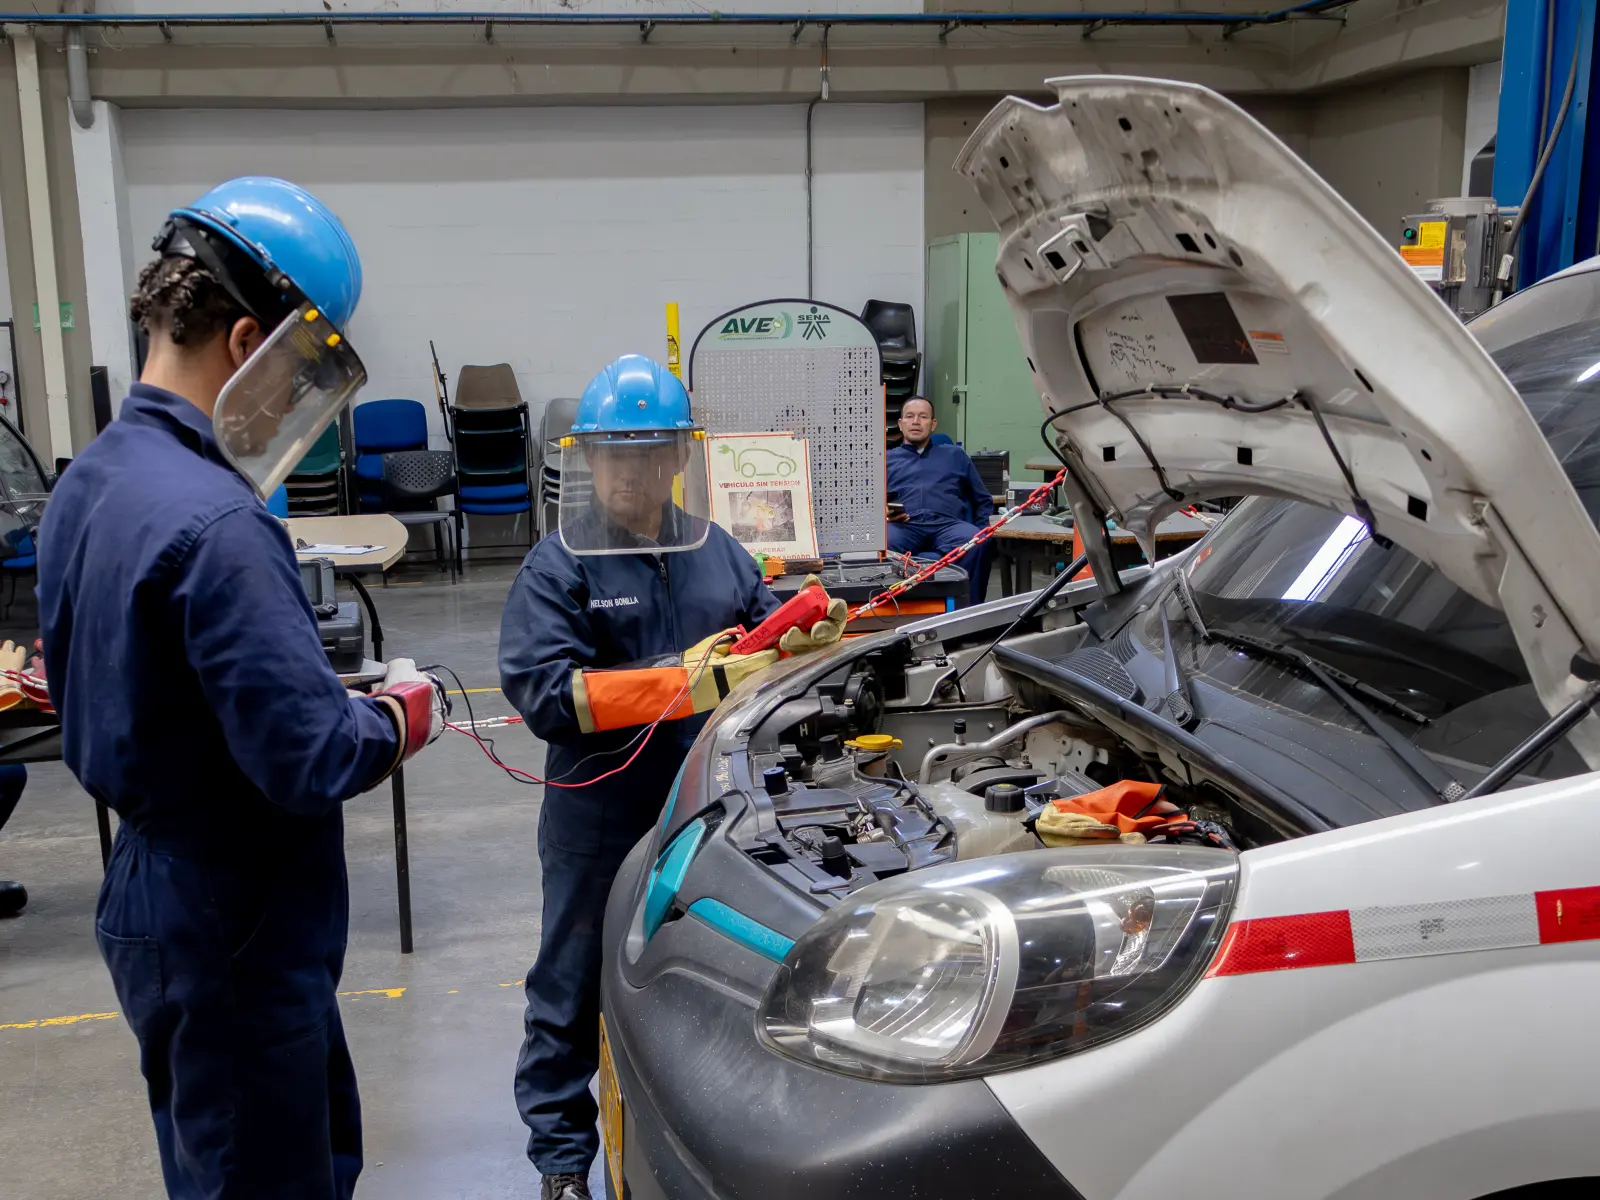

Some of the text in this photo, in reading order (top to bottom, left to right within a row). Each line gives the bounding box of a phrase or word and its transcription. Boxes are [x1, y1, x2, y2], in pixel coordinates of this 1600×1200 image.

[720, 317, 775, 334] AVE
[590, 596, 639, 608] NELSON BONILLA
